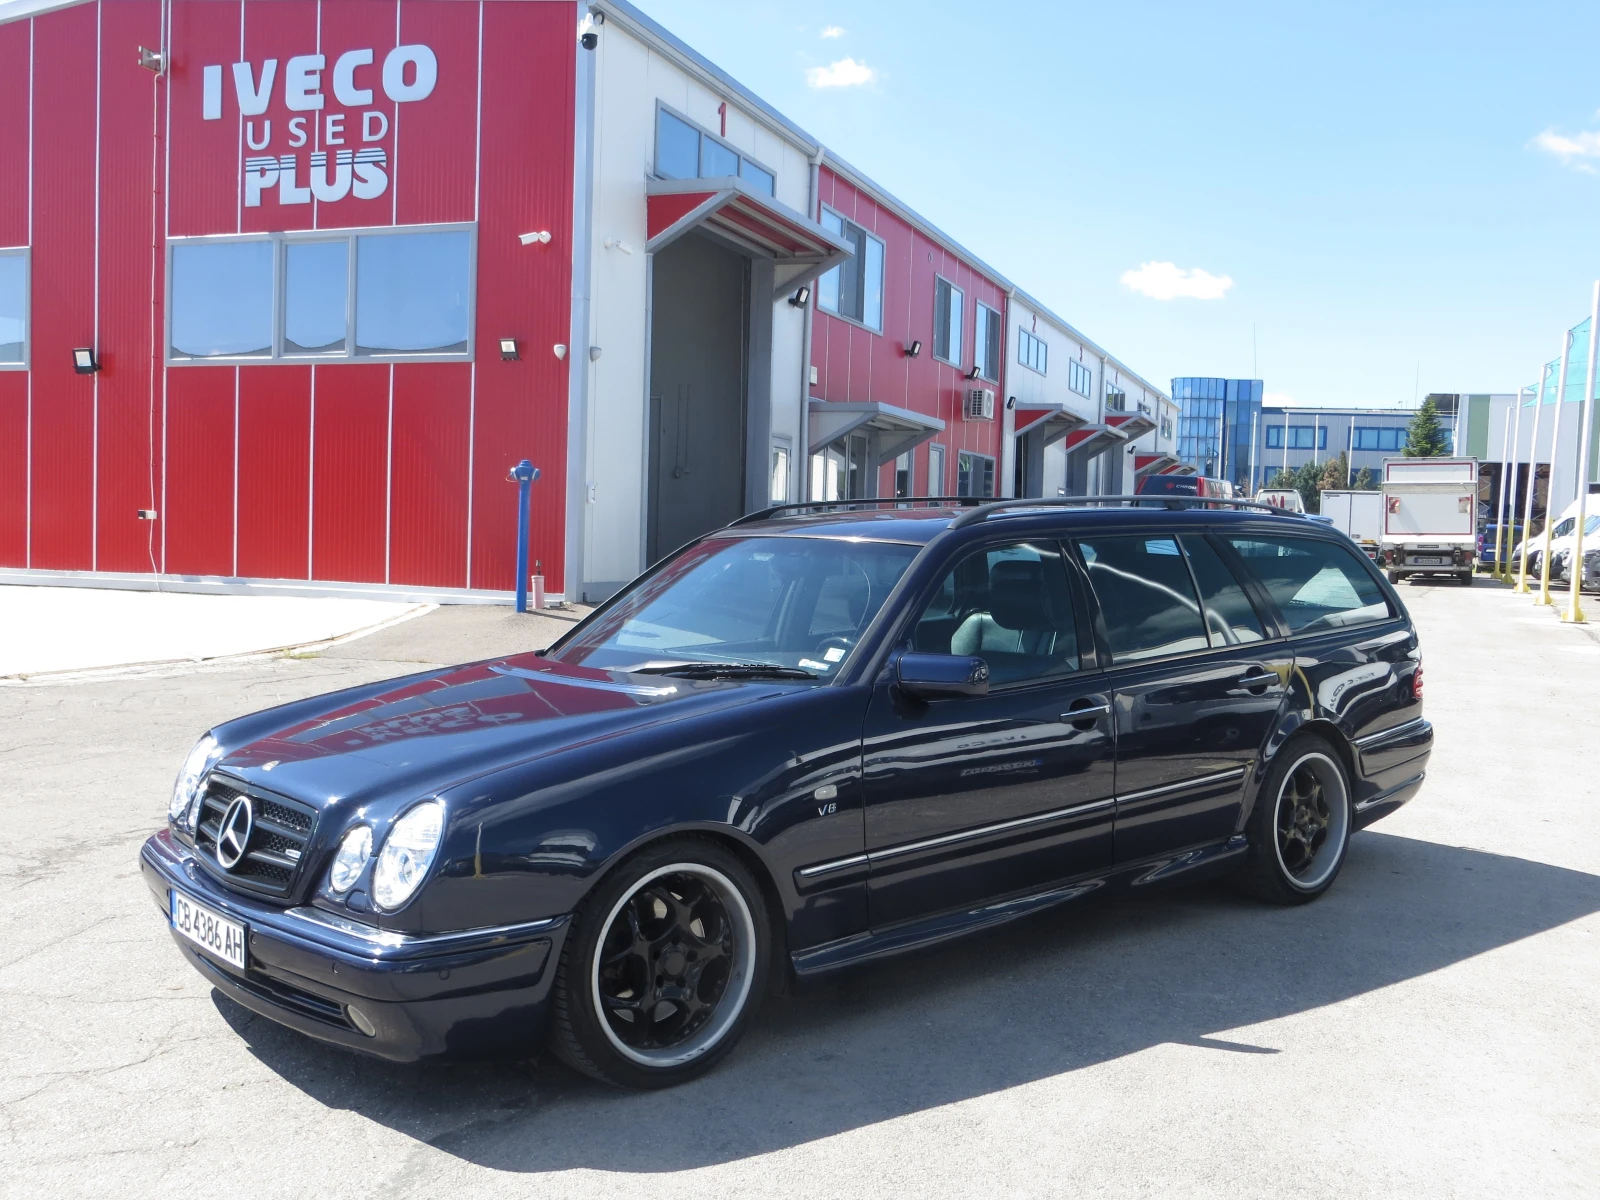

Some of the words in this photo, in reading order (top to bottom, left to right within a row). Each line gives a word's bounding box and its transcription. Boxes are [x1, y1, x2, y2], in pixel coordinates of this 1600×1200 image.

[203, 44, 437, 120] IVECO
[246, 111, 388, 150] USED
[718, 101, 727, 138] 1
[245, 147, 388, 207] PLUS
[1031, 314, 1037, 334] 2
[177, 898, 192, 933] CB
[193, 908, 222, 951] 4386
[224, 924, 243, 963] AH
